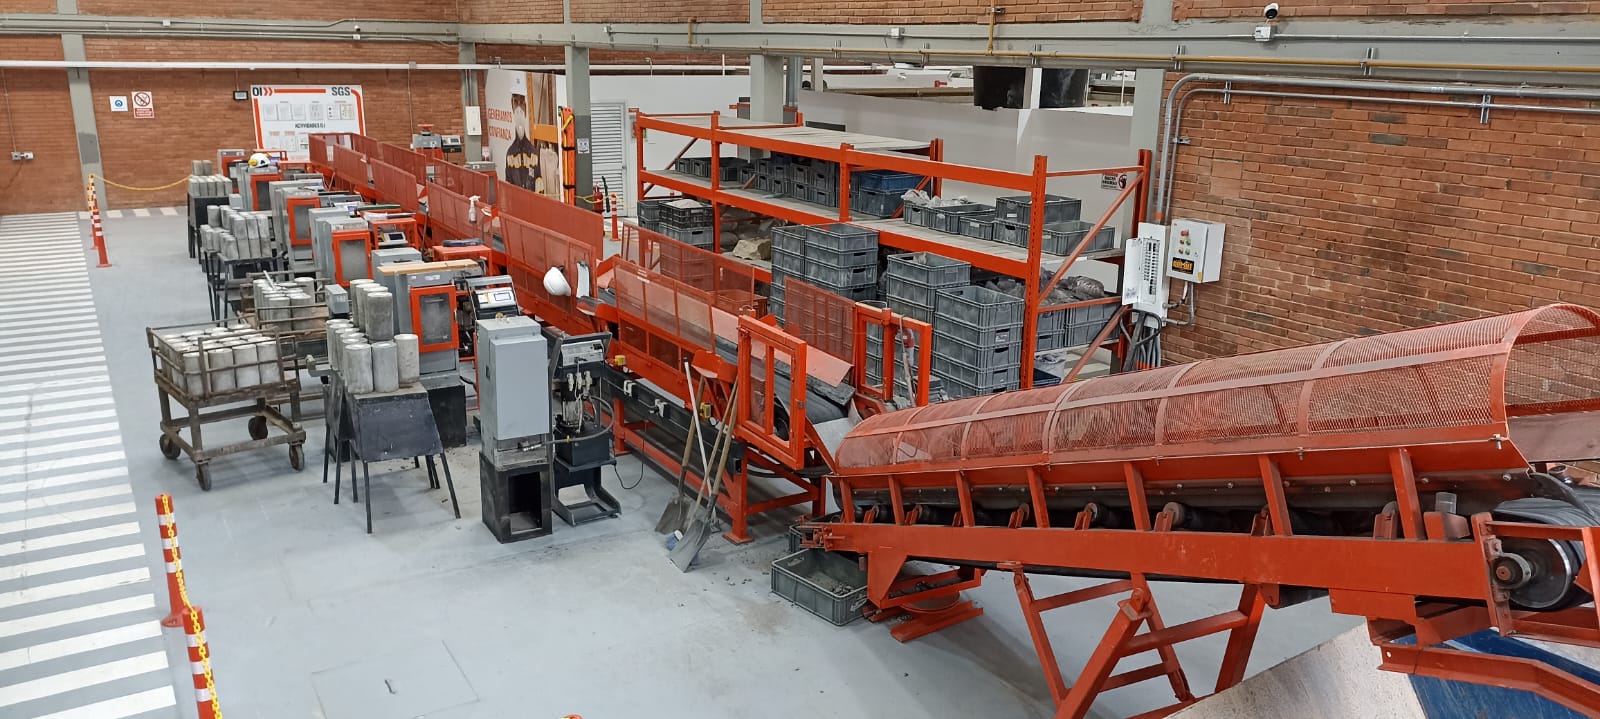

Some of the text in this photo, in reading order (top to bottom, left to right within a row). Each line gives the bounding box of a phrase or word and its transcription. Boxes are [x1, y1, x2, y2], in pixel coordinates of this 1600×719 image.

[331, 87, 351, 96] SGS
[488, 108, 512, 123] GENERAMOS
[488, 125, 512, 141] CONFIANZA
